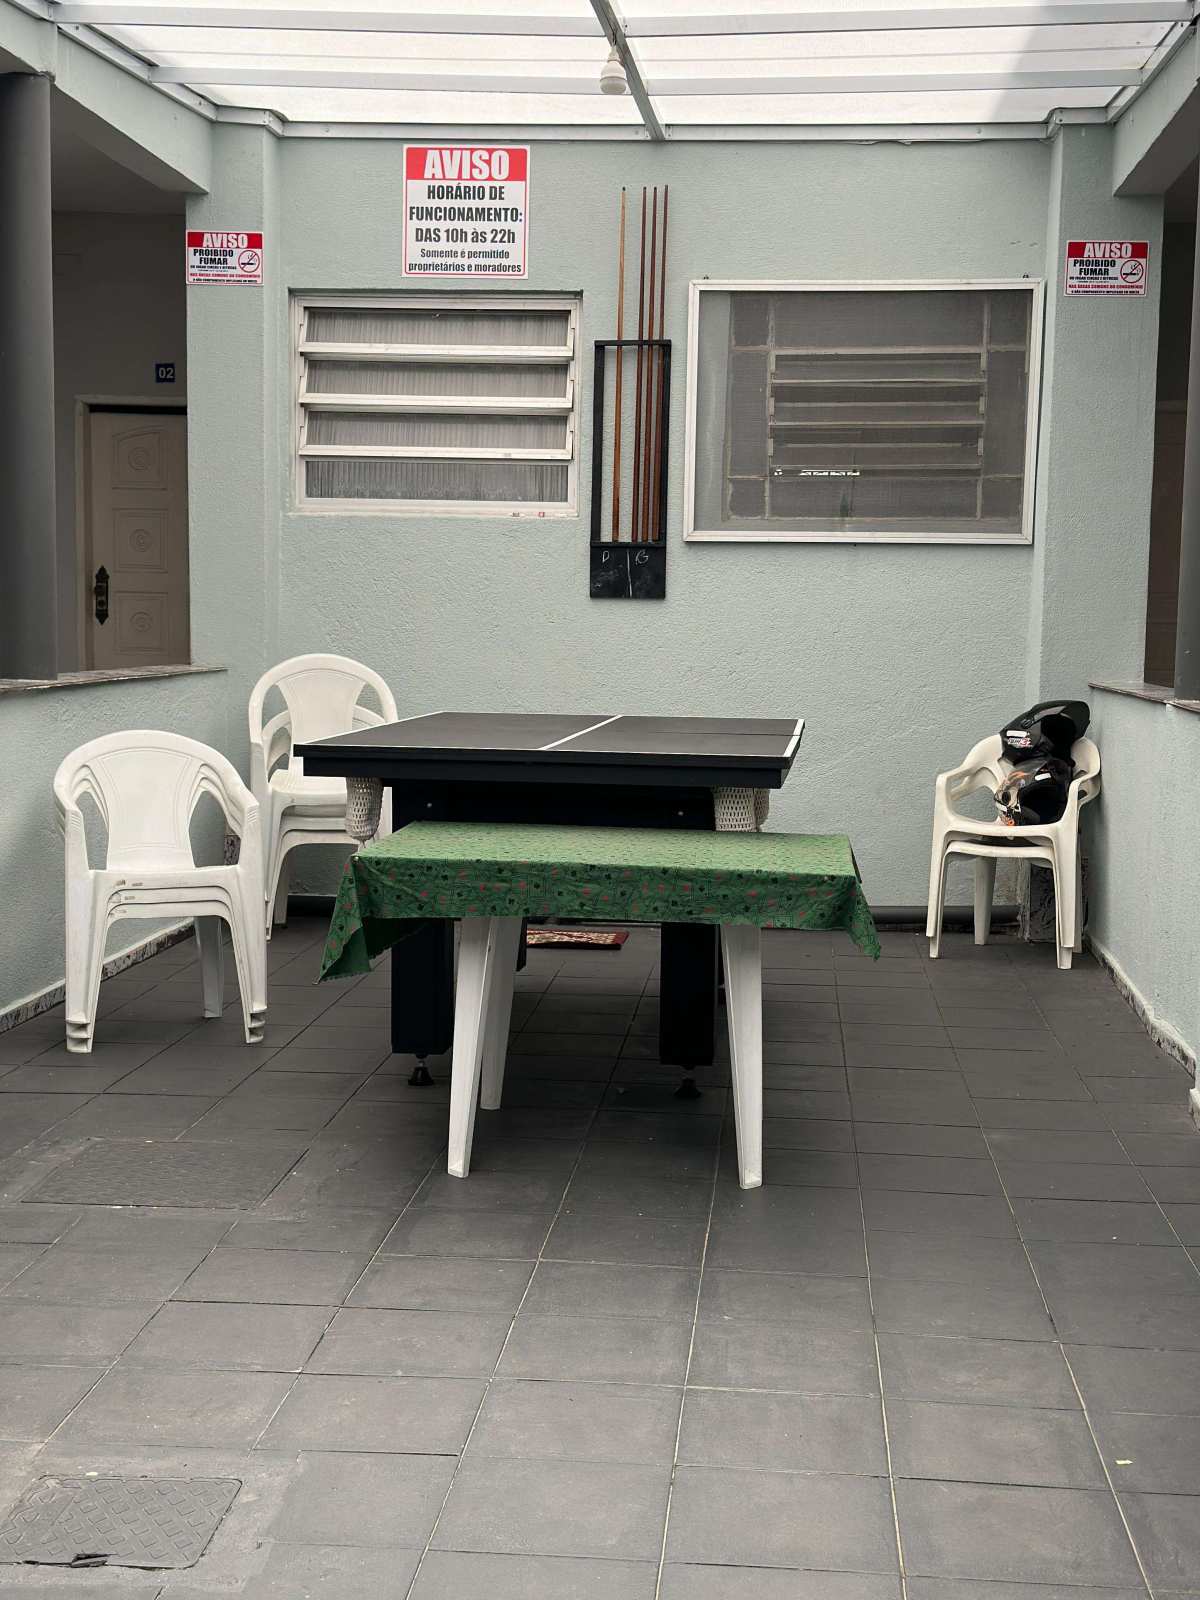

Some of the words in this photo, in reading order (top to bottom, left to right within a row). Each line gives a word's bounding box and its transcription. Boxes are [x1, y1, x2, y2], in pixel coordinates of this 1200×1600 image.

[424, 149, 510, 180] AVISO
[427, 182, 486, 201] HORÁRIO
[489, 185, 505, 201] DE
[409, 205, 523, 222] FUNCIONAMENTO:
[202, 233, 248, 249] AVISO
[415, 227, 441, 243] DAS
[444, 227, 468, 243] 10h
[471, 228, 488, 244] às
[490, 228, 516, 244] 22h
[193, 248, 234, 257] PROIBIDO
[420, 248, 459, 259] Somente
[460, 248, 466, 259] é
[467, 249, 510, 260] permitido
[1083, 242, 1133, 258] AVISO
[200, 257, 228, 266] FUMAR
[408, 261, 466, 273] proprietários
[467, 264, 473, 272] e
[474, 262, 522, 273] moradores
[1073, 258, 1117, 268] PROIBIDO
[1079, 267, 1110, 276] FUMAR
[159, 367, 174, 379] 02
